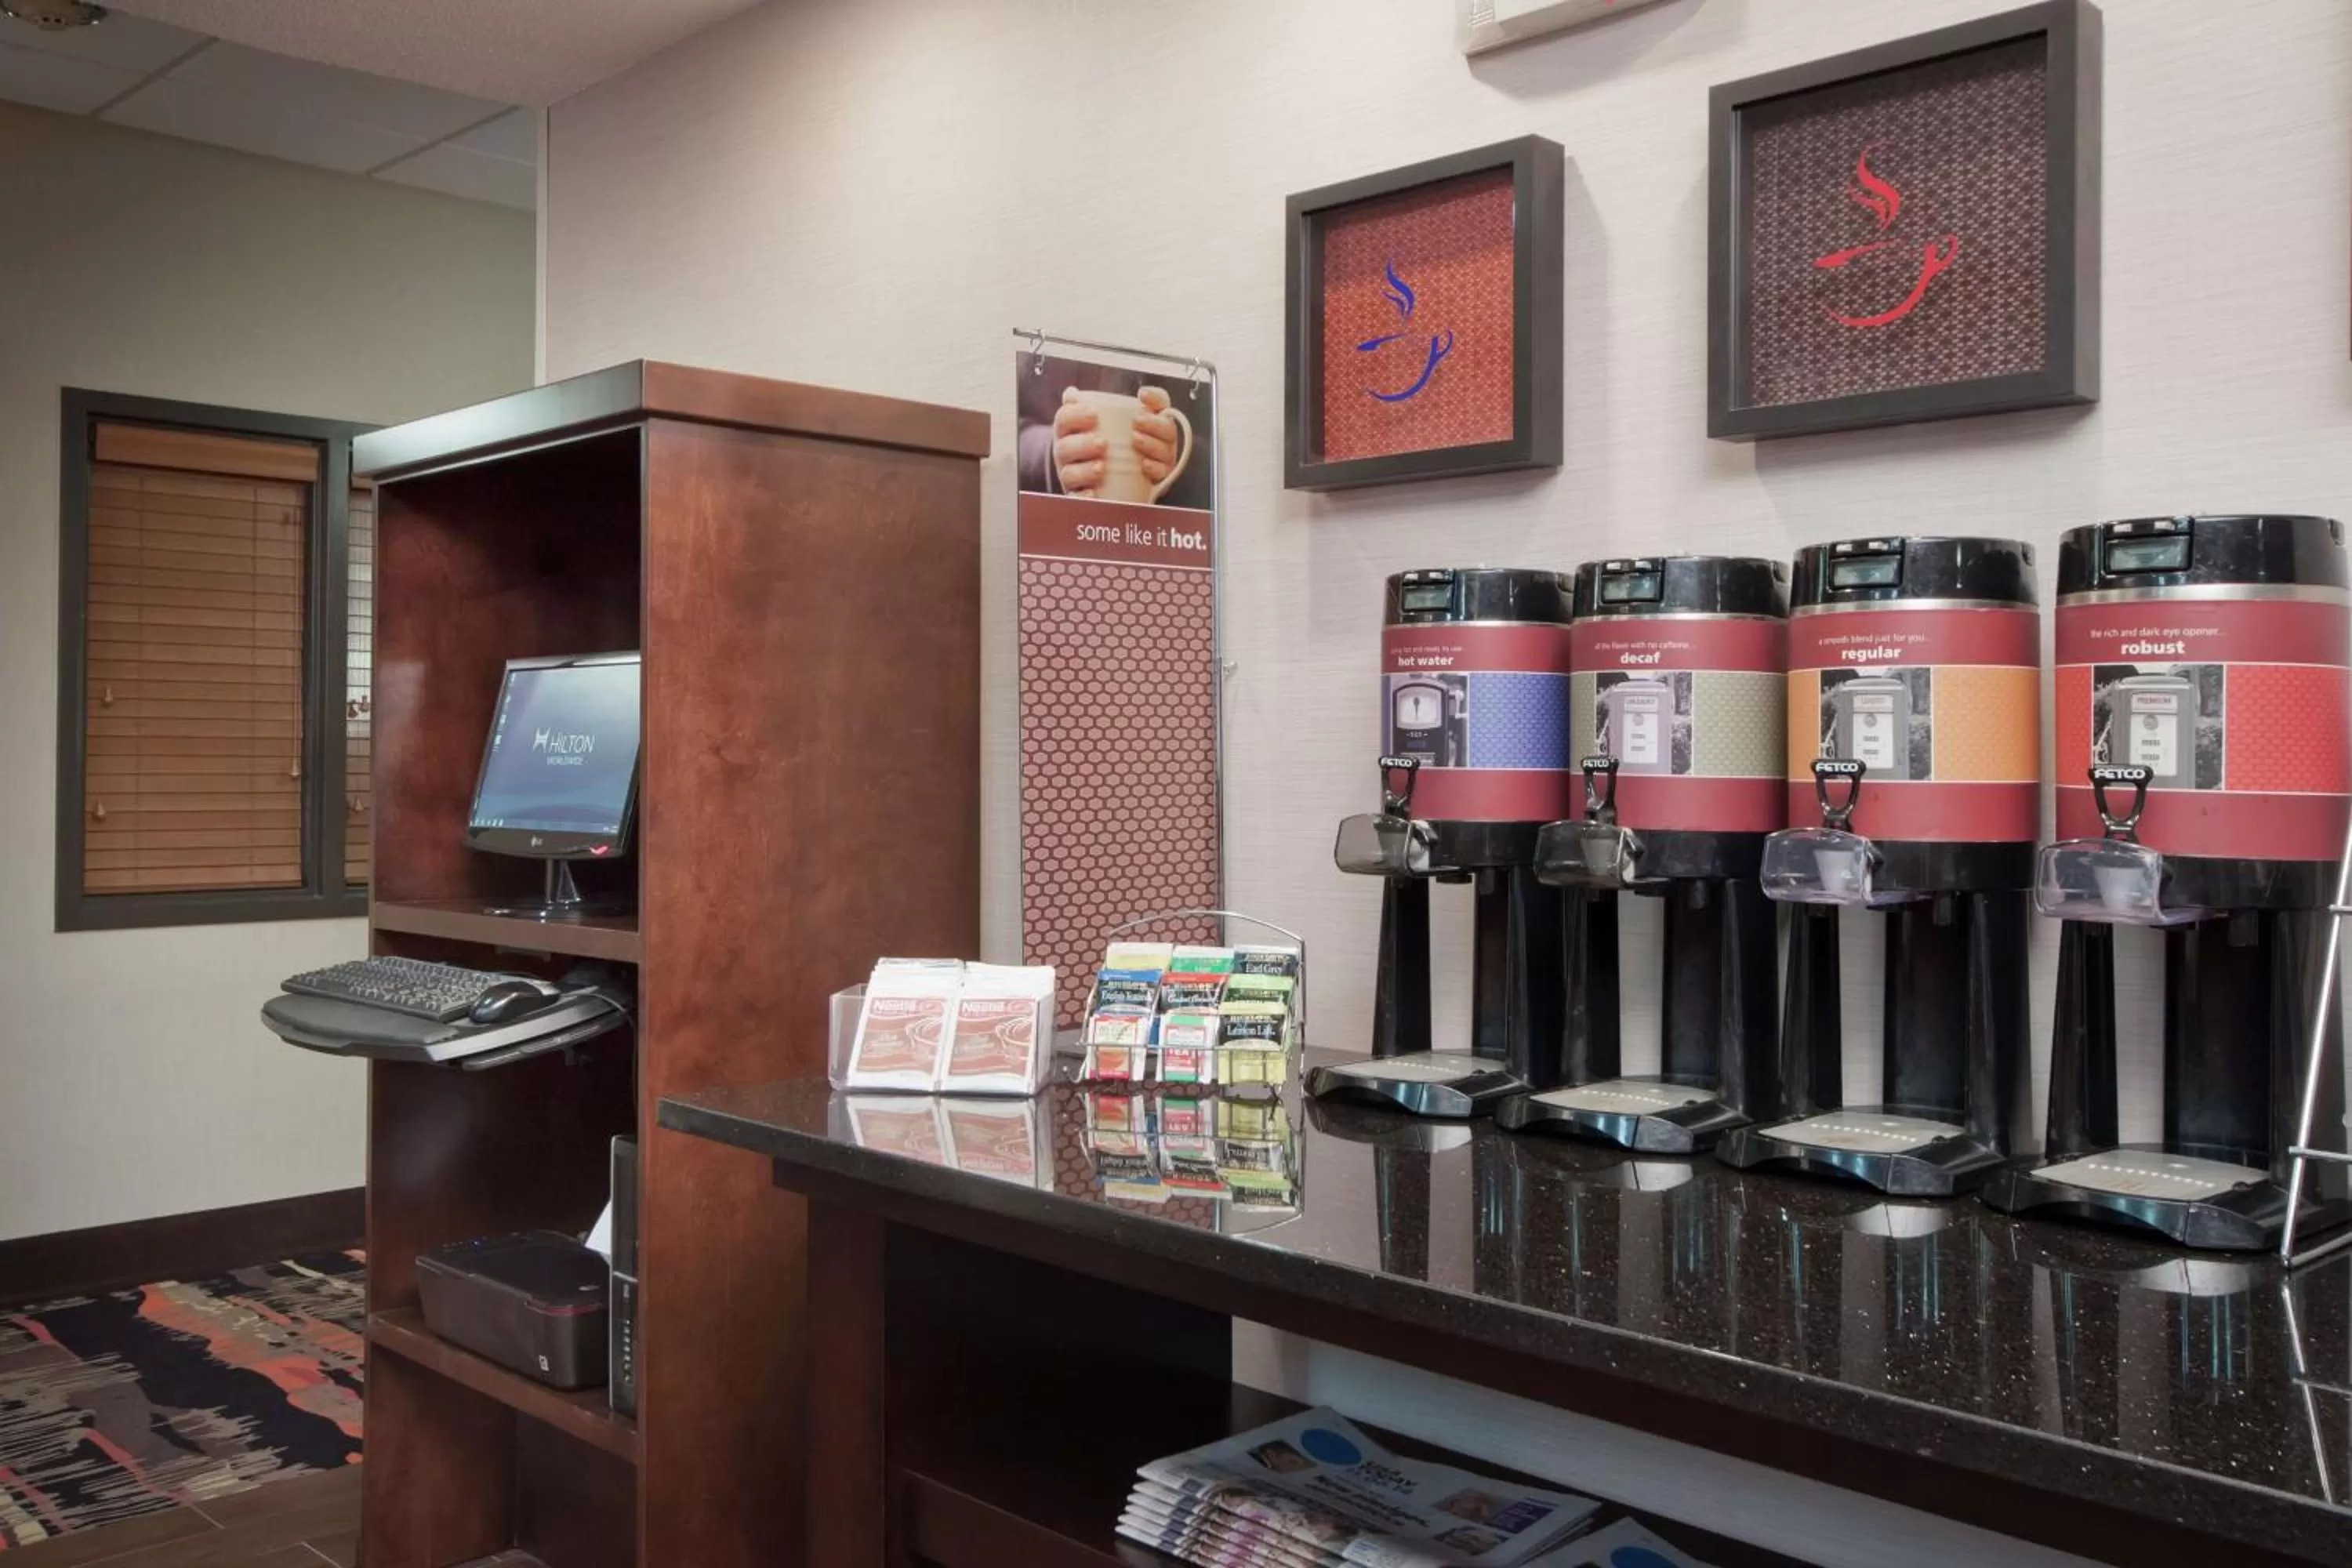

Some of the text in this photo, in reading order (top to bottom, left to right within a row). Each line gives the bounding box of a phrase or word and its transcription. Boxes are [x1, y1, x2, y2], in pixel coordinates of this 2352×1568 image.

[1076, 523, 1207, 550] some like it hot.
[1851, 633, 1873, 644] blend
[1875, 633, 1891, 644] just
[1893, 633, 1906, 643] for
[2120, 628, 2137, 637] and
[2139, 627, 2160, 637] dark
[2162, 629, 2180, 639] eye
[2121, 640, 2186, 655] robust
[1621, 652, 1661, 664] decaf
[1842, 645, 1902, 662] regular
[1398, 655, 1454, 666] hot water
[549, 734, 595, 753] HILTON
[1381, 757, 1413, 768] FETCO
[1583, 758, 1610, 768] FETCO
[1816, 763, 1859, 772] FETCO
[2094, 768, 2146, 779] FETCO
